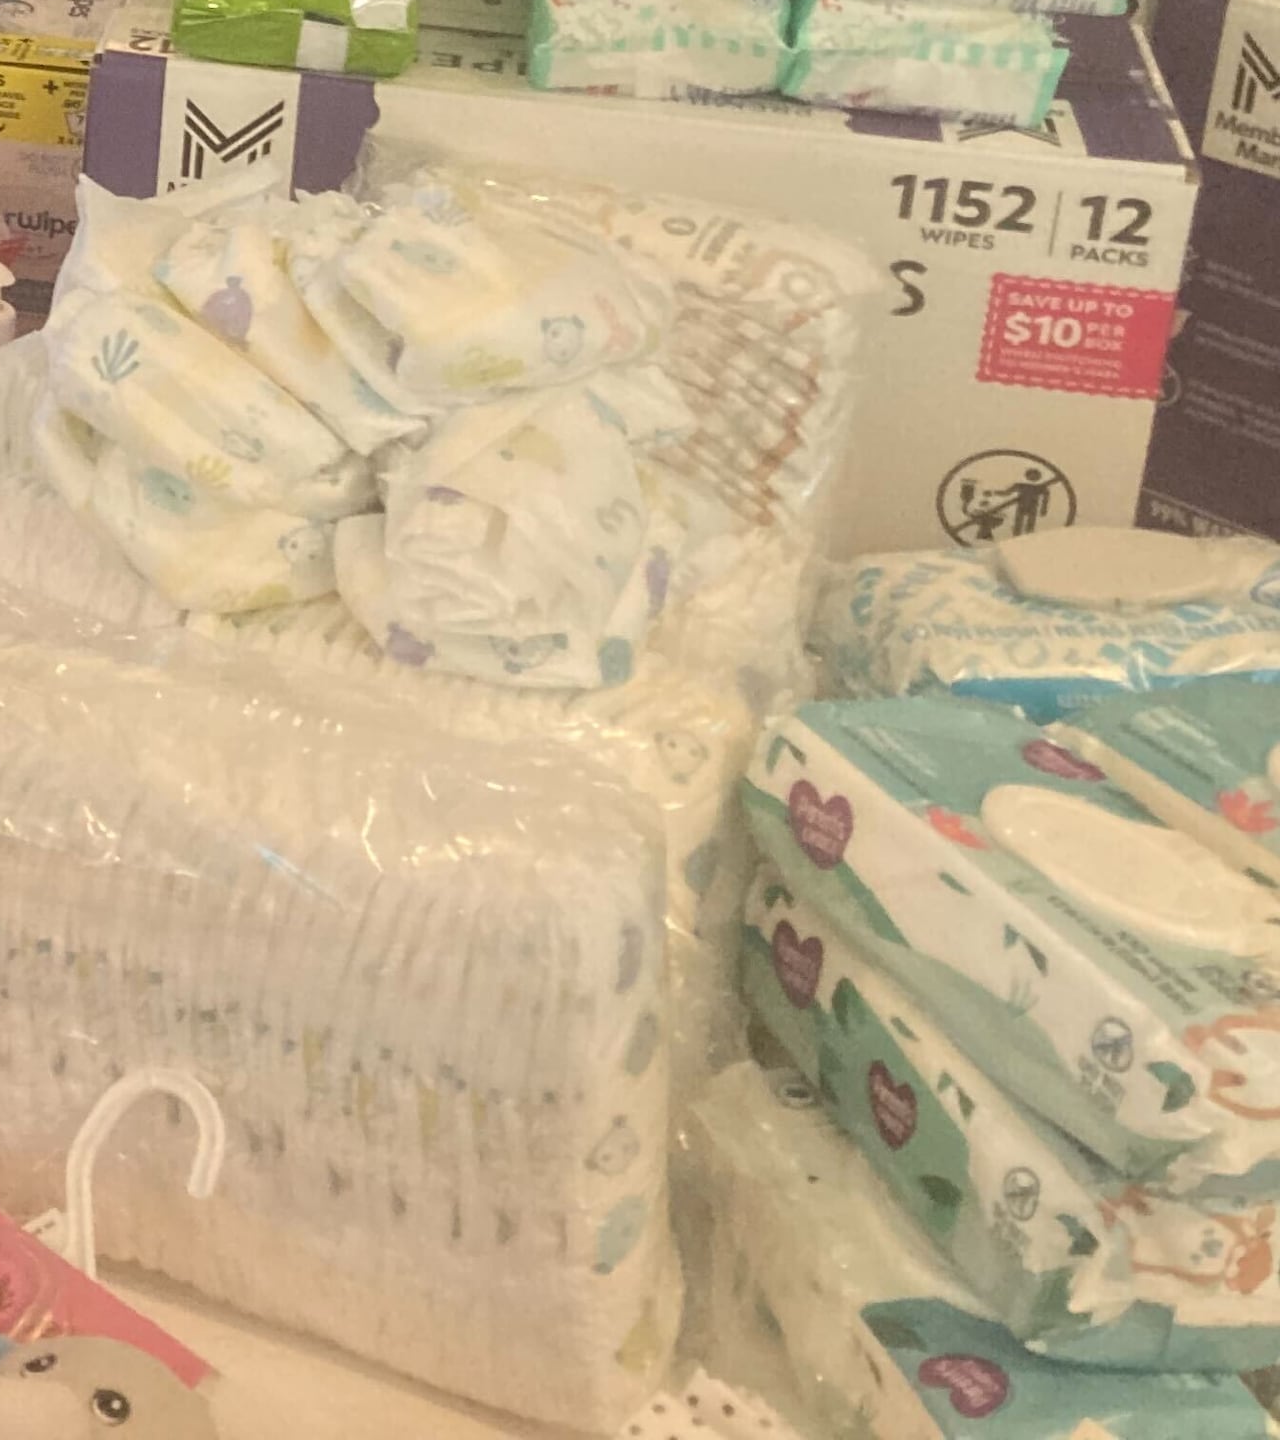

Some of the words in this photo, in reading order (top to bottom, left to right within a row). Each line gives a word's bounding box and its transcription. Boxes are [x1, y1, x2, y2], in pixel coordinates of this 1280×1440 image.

[890, 174, 1038, 235] 1152
[1080, 195, 1154, 247] 12
[920, 226, 996, 252] WIPES
[1069, 242, 1151, 269] PACKS
[889, 259, 929, 317] S
[1006, 290, 1063, 311] SAVE
[1067, 297, 1101, 314] UP
[1102, 300, 1136, 320] TO
[1001, 310, 1085, 350] $10
[1083, 336, 1124, 353] BOX
[1086, 321, 1127, 338] PER
